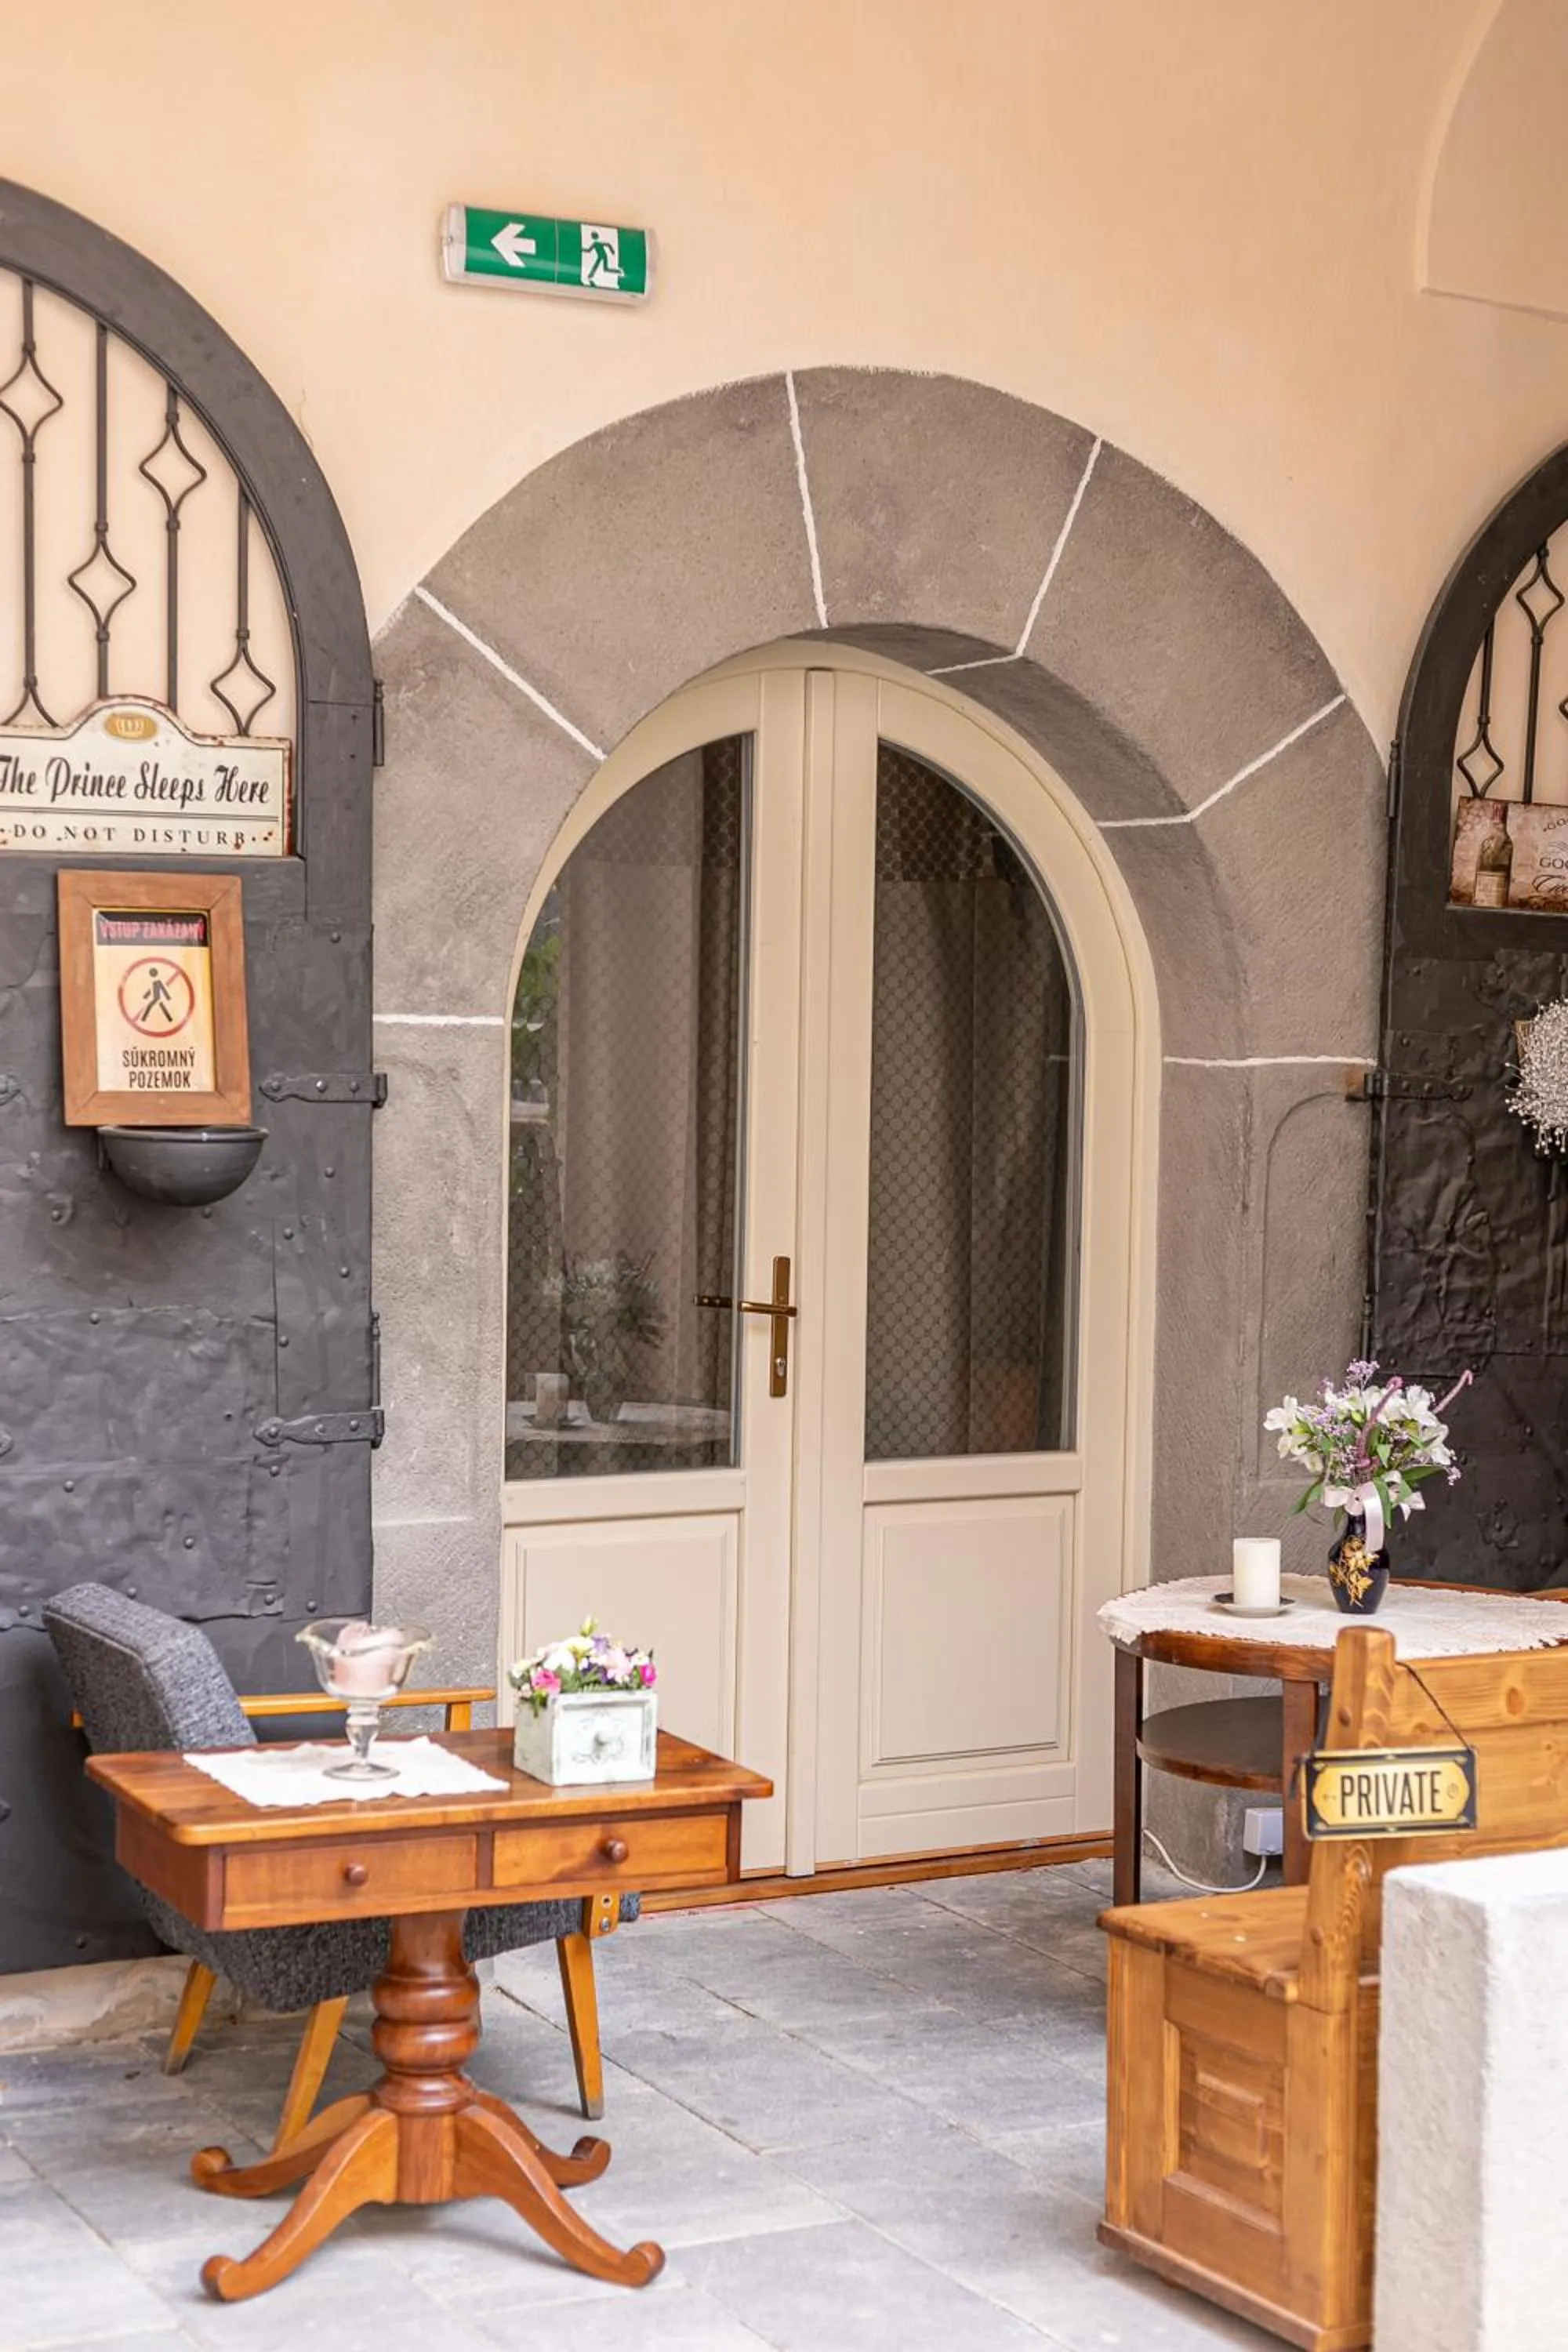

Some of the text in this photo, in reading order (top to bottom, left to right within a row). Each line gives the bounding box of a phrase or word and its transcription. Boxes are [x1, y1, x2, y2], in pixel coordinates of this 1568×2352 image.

[0, 754, 270, 809] The Prince Sleeps Here
[14, 824, 245, 845] DO NOT DISTURB
[100, 920, 140, 939] VSTUP
[122, 1046, 196, 1068] SÚKROMNÝ
[129, 1070, 191, 1090] POZEMOK
[1341, 1771, 1443, 1817] PRIVATE
